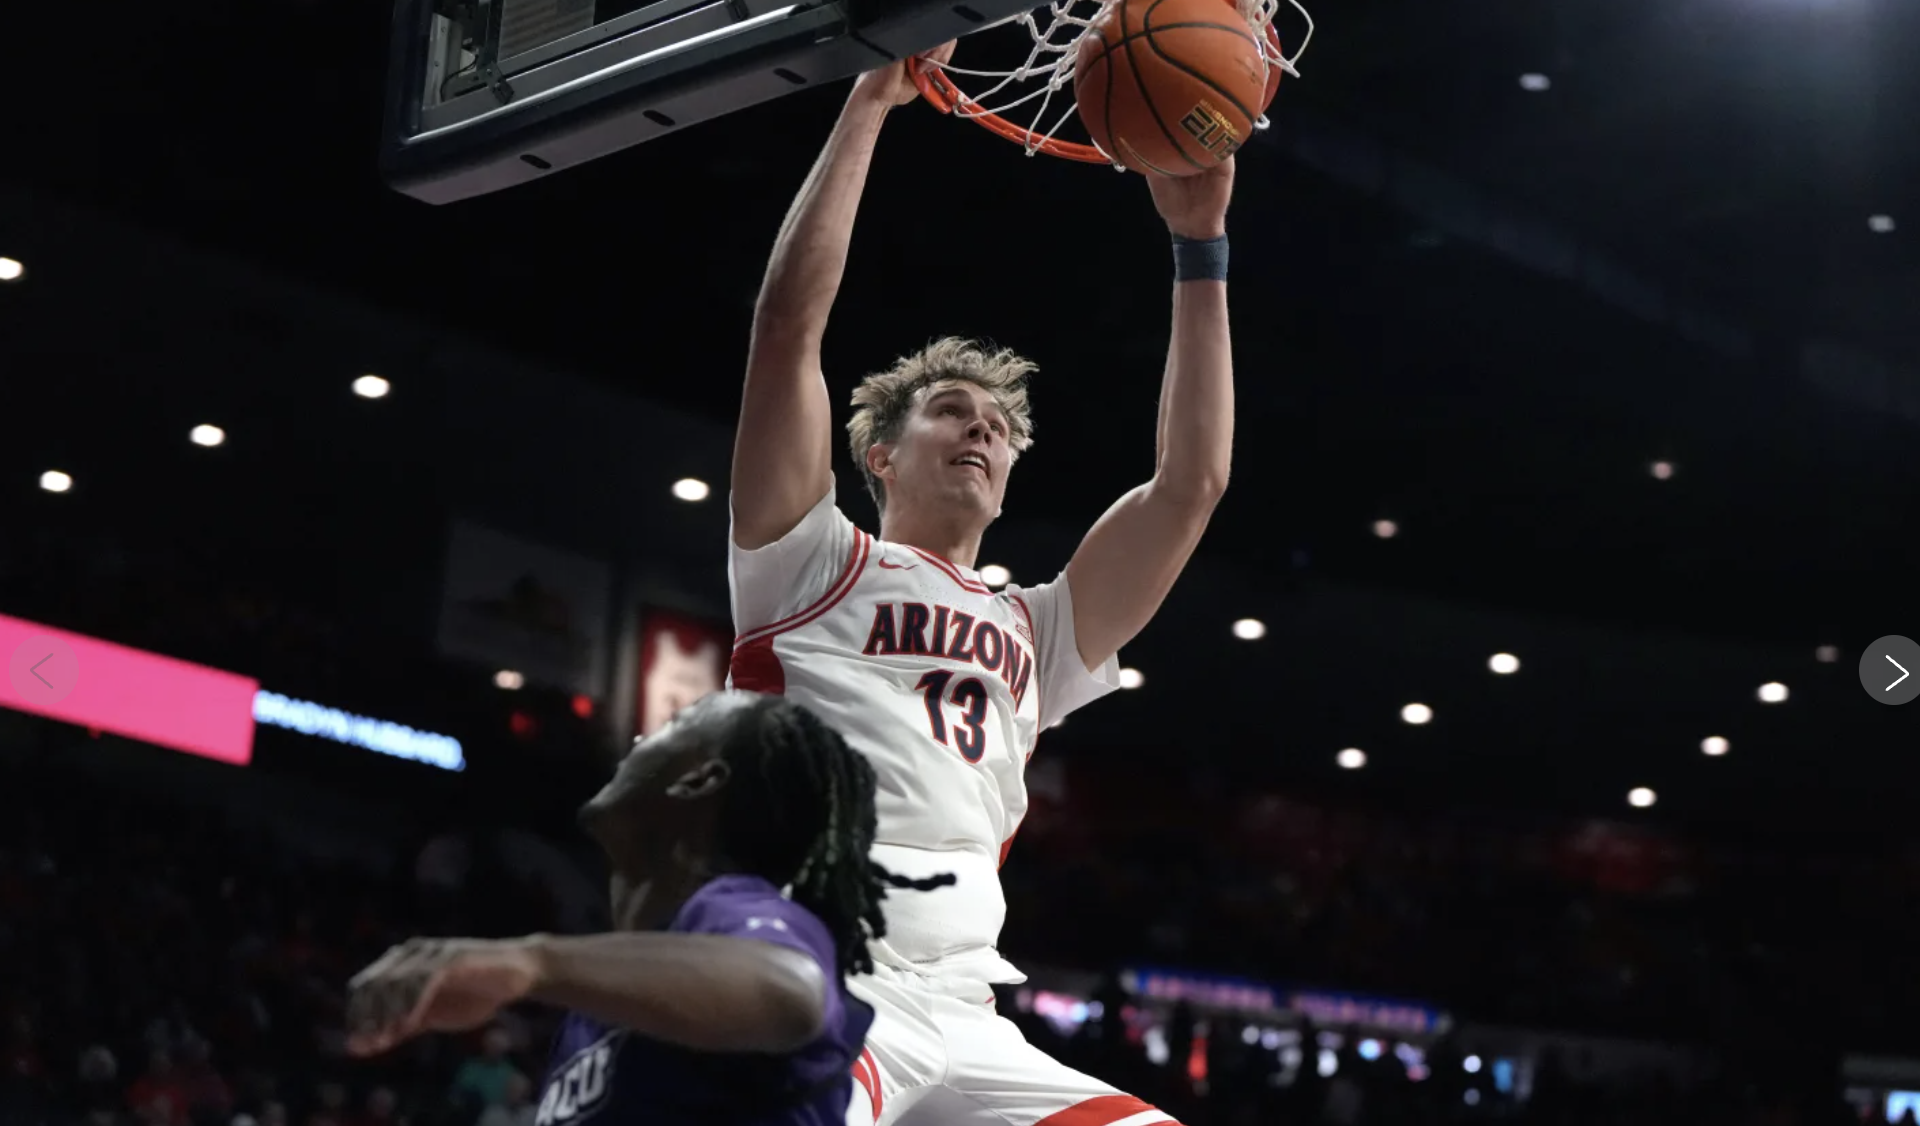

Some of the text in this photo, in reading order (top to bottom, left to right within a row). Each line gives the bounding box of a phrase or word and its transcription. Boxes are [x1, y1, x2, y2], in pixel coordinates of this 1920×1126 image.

[862, 602, 1032, 714] ARIZONA
[914, 669, 988, 764] 13
[534, 1045, 612, 1126] ACU
